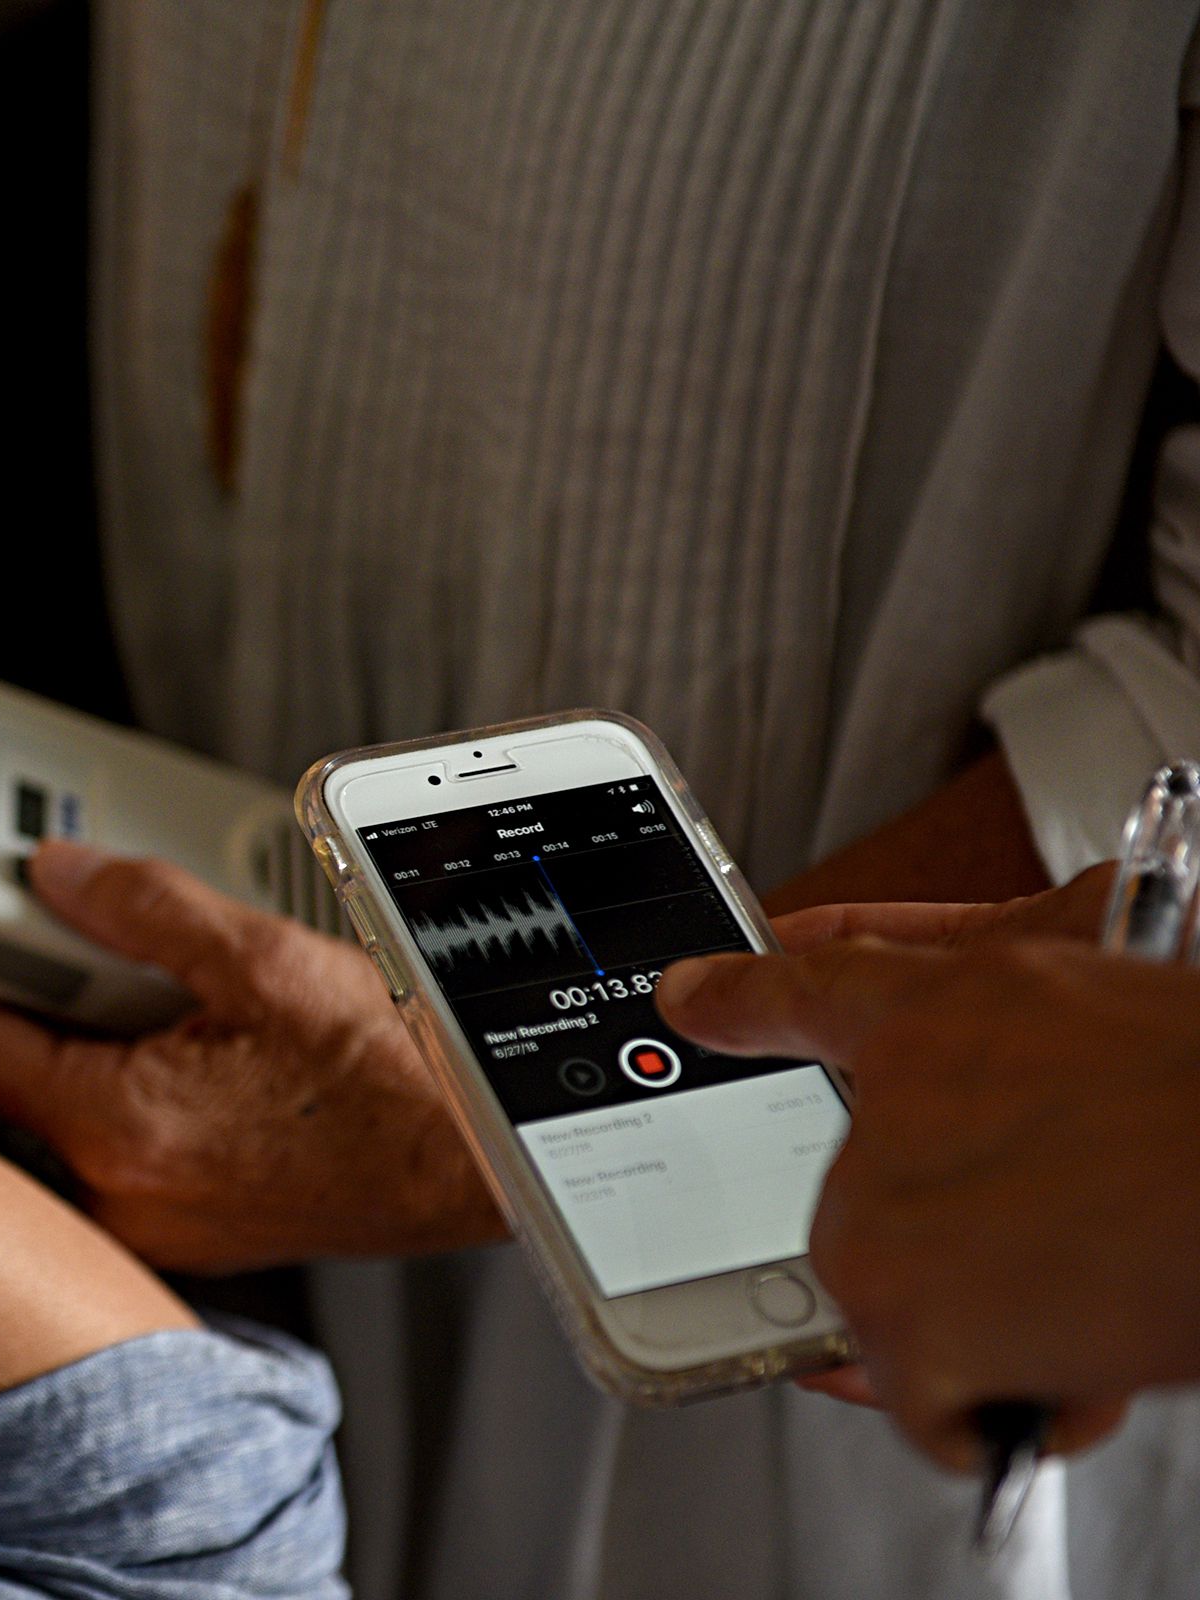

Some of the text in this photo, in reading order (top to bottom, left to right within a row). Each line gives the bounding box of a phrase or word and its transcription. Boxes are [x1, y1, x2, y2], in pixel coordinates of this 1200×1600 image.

[487, 802, 533, 818] 12:46 PM
[381, 820, 439, 838] Verizon LTE
[497, 822, 545, 840] Record
[394, 823, 667, 881] 00:11 00:12 00:13 00:14 00:15 00:16
[484, 1012, 600, 1045] New Recording 2
[493, 1041, 540, 1059] 6/27/18
[540, 1112, 654, 1145] New Recording 2
[596, 1159, 667, 1182] Recording
